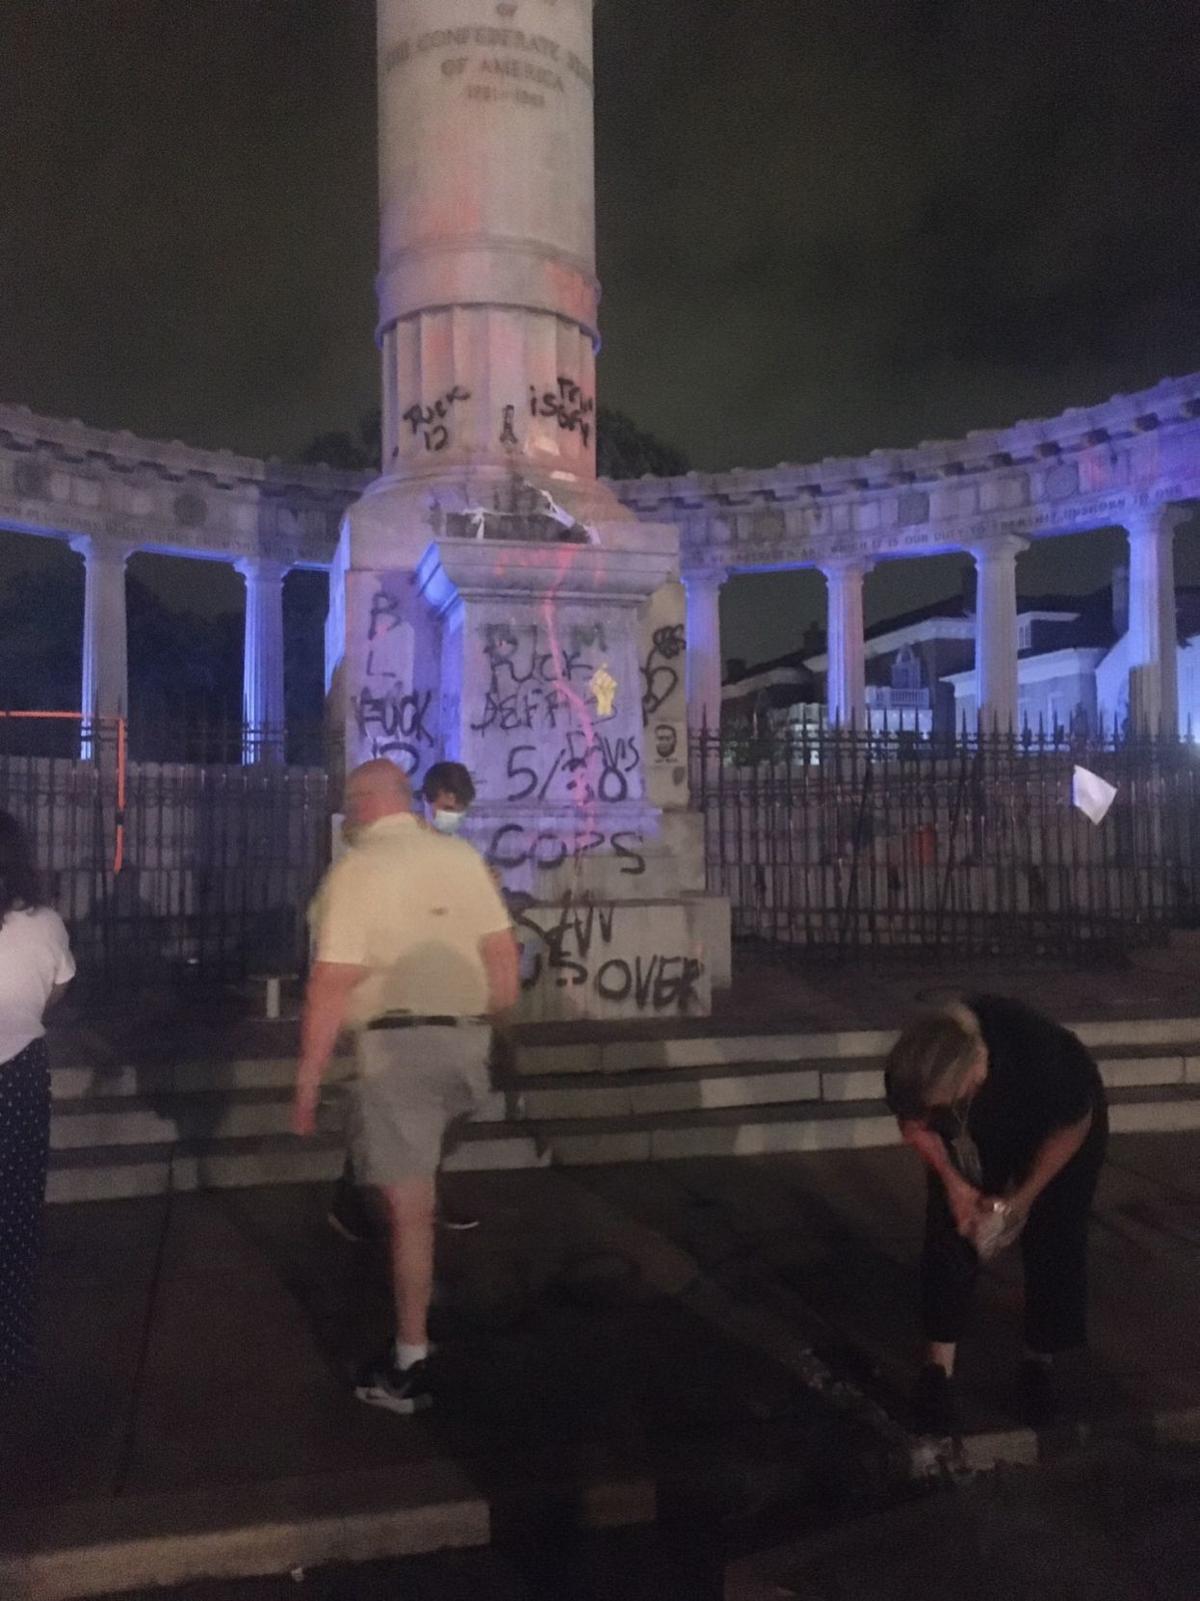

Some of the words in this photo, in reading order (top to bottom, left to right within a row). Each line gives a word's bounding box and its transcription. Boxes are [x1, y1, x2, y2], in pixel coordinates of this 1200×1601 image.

[904, 533, 929, 545] OUR
[487, 823, 646, 875] COPS
[596, 953, 705, 1012] OVER
